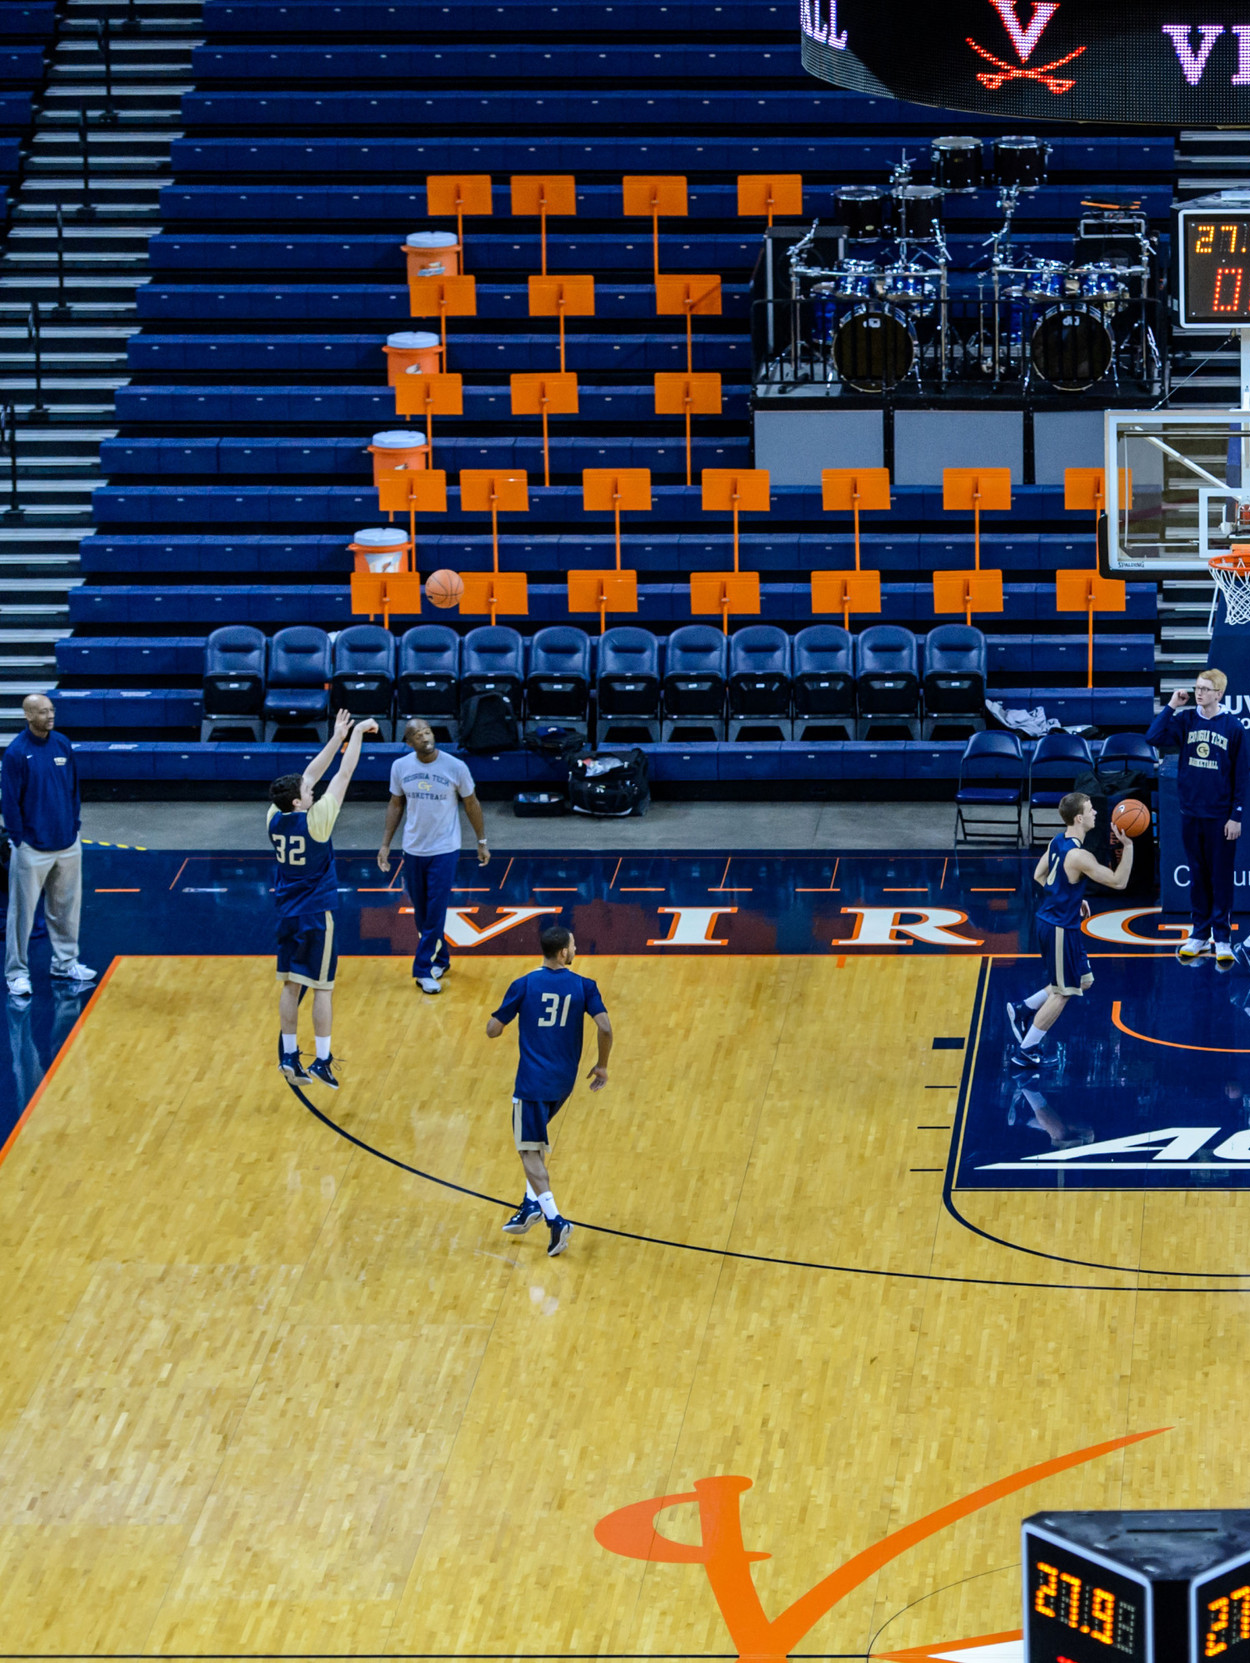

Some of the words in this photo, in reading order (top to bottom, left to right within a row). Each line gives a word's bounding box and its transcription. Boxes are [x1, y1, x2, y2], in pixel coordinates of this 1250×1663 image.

[272, 833, 306, 866] 32
[537, 992, 572, 1027] 31
[1035, 1561, 1115, 1646] 27.9
